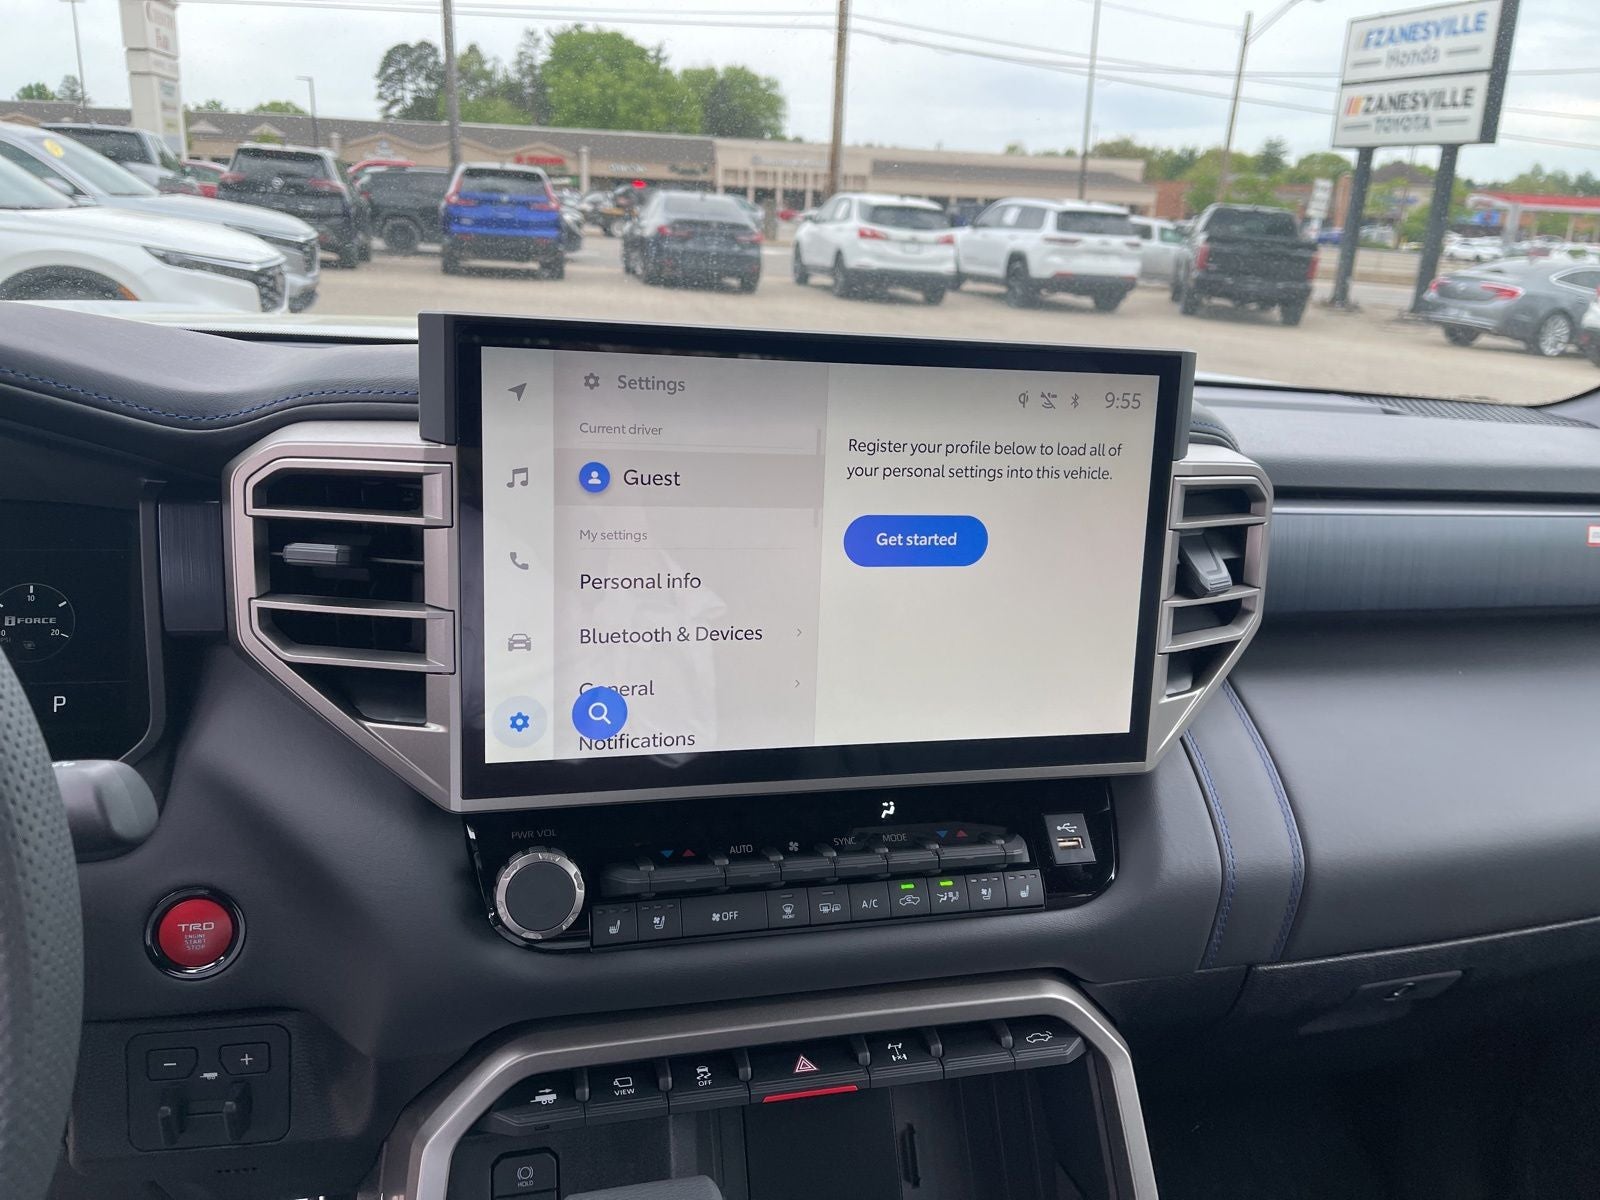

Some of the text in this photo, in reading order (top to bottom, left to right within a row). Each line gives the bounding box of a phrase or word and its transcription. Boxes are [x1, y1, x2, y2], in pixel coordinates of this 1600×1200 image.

[1371, 12, 1486, 47] ZANESVILLE
[1363, 87, 1474, 115] ZANESVILLE
[1374, 115, 1432, 134] TOYOTA
[617, 374, 686, 396] Settings
[1104, 392, 1142, 410] 9:55
[579, 422, 663, 436] Current driver
[848, 438, 1122, 457] Register your profile below to load all of
[623, 468, 681, 487] Guest
[846, 464, 1113, 481] your personal settings into this vehicle.
[579, 529, 648, 543] My settings
[876, 531, 957, 546] Get started
[580, 572, 701, 590] Personal info
[27, 594, 35, 602] 10
[50, 628, 60, 636] 20
[580, 625, 763, 644] Bluetooth & Devices
[579, 679, 655, 697] Gneral
[53, 695, 67, 713] P
[579, 732, 696, 752] Notifications
[511, 828, 557, 839] PWR VOL
[833, 835, 857, 846] SYNC
[882, 832, 908, 843] MODE
[729, 844, 753, 855] AUTO
[861, 898, 879, 909] A/C
[721, 910, 739, 922] OFF
[177, 922, 214, 931] TRD
[697, 1079, 713, 1087] OFF
[613, 1087, 635, 1096] VIEW
[517, 1179, 534, 1188] HOLD
